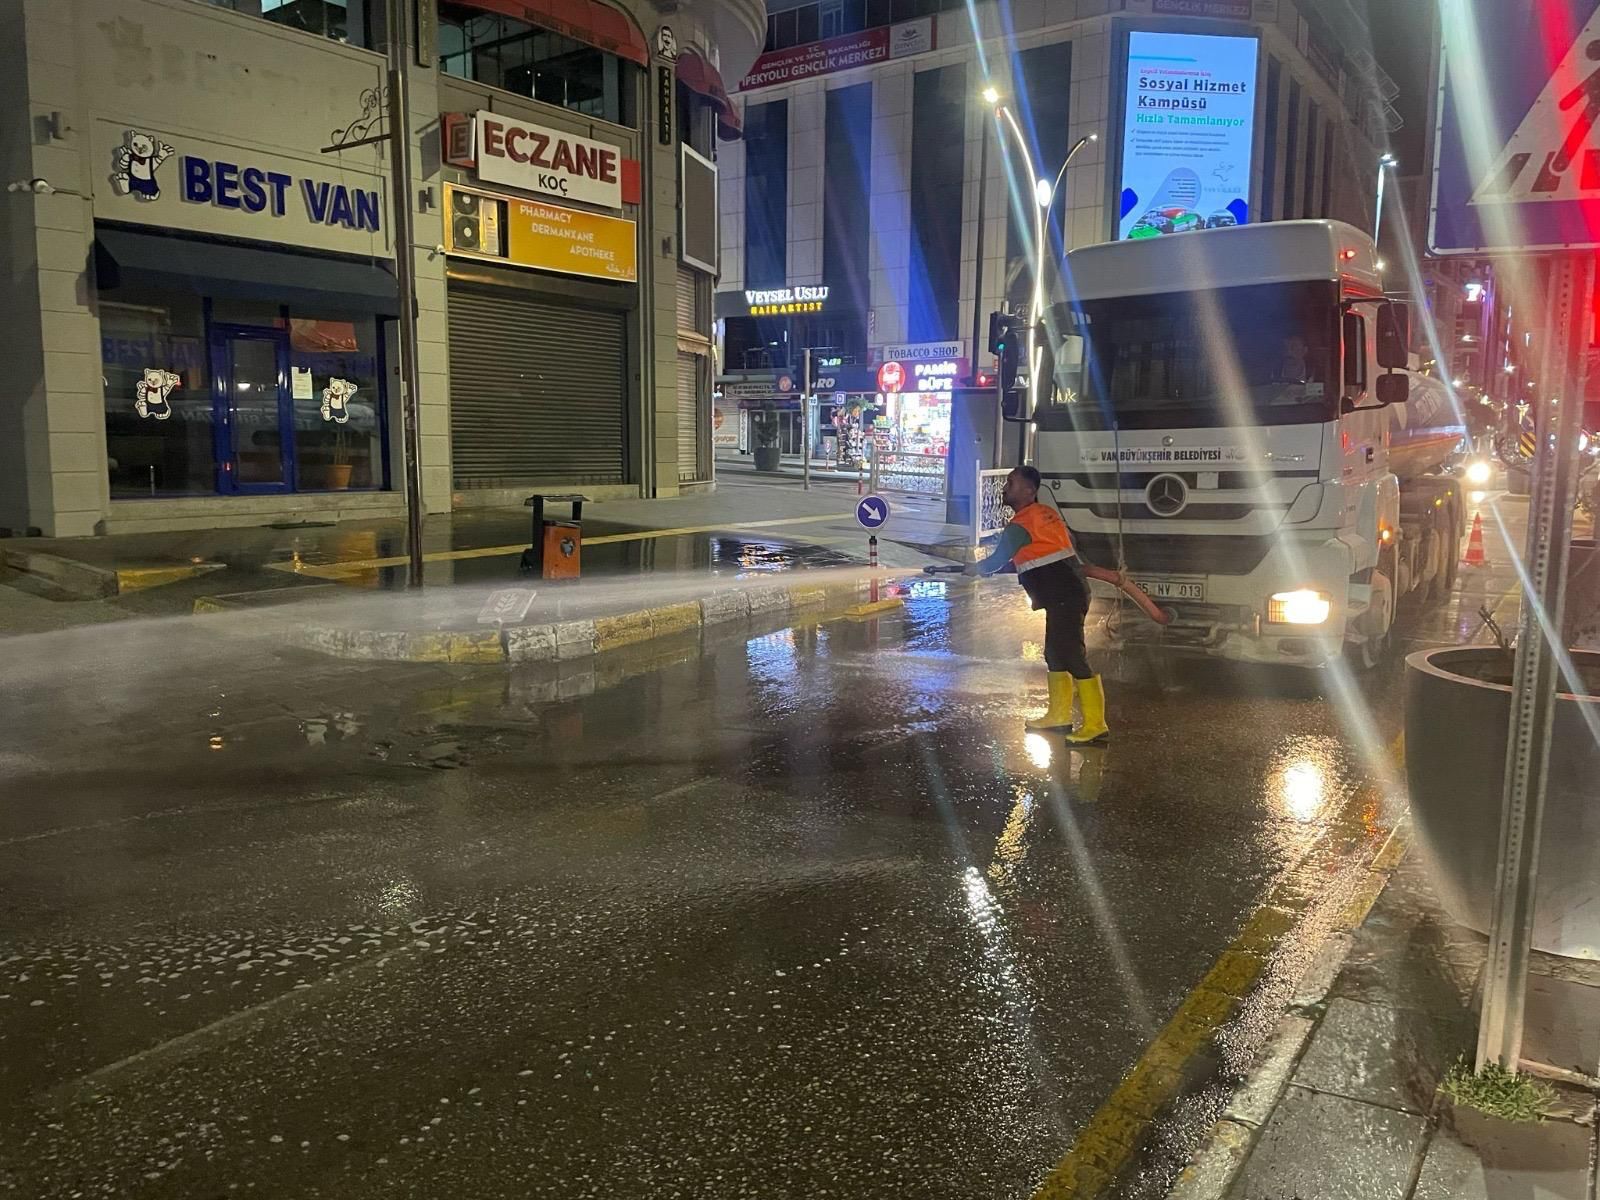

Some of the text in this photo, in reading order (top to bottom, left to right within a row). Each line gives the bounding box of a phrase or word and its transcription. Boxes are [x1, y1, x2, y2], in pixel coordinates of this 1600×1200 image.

[791, 57, 836, 76] GENÇLİK
[838, 46, 886, 66] MERKEZİ
[1139, 77, 1247, 92] Sosyal Hizmet
[1138, 95, 1207, 110] Kampüsü
[1136, 113, 1245, 127] Hızla Tamamlanıyor
[484, 120, 617, 184] ECZANE
[538, 173, 568, 195] KOÇ
[180, 156, 380, 231] BEST VAN
[520, 205, 573, 224] PHARMACY
[532, 223, 594, 243] DERMANXANE
[570, 245, 615, 260] APOTHEKE
[745, 286, 829, 304] VEYSEL USLU
[888, 346, 958, 359] TOBACCO SHOP
[1101, 450, 1118, 461] VAN
[1120, 448, 1172, 463] BÜYÜKŞEHİR
[1174, 447, 1221, 461] BELEDİYESİ
[1180, 585, 1201, 597] 013
